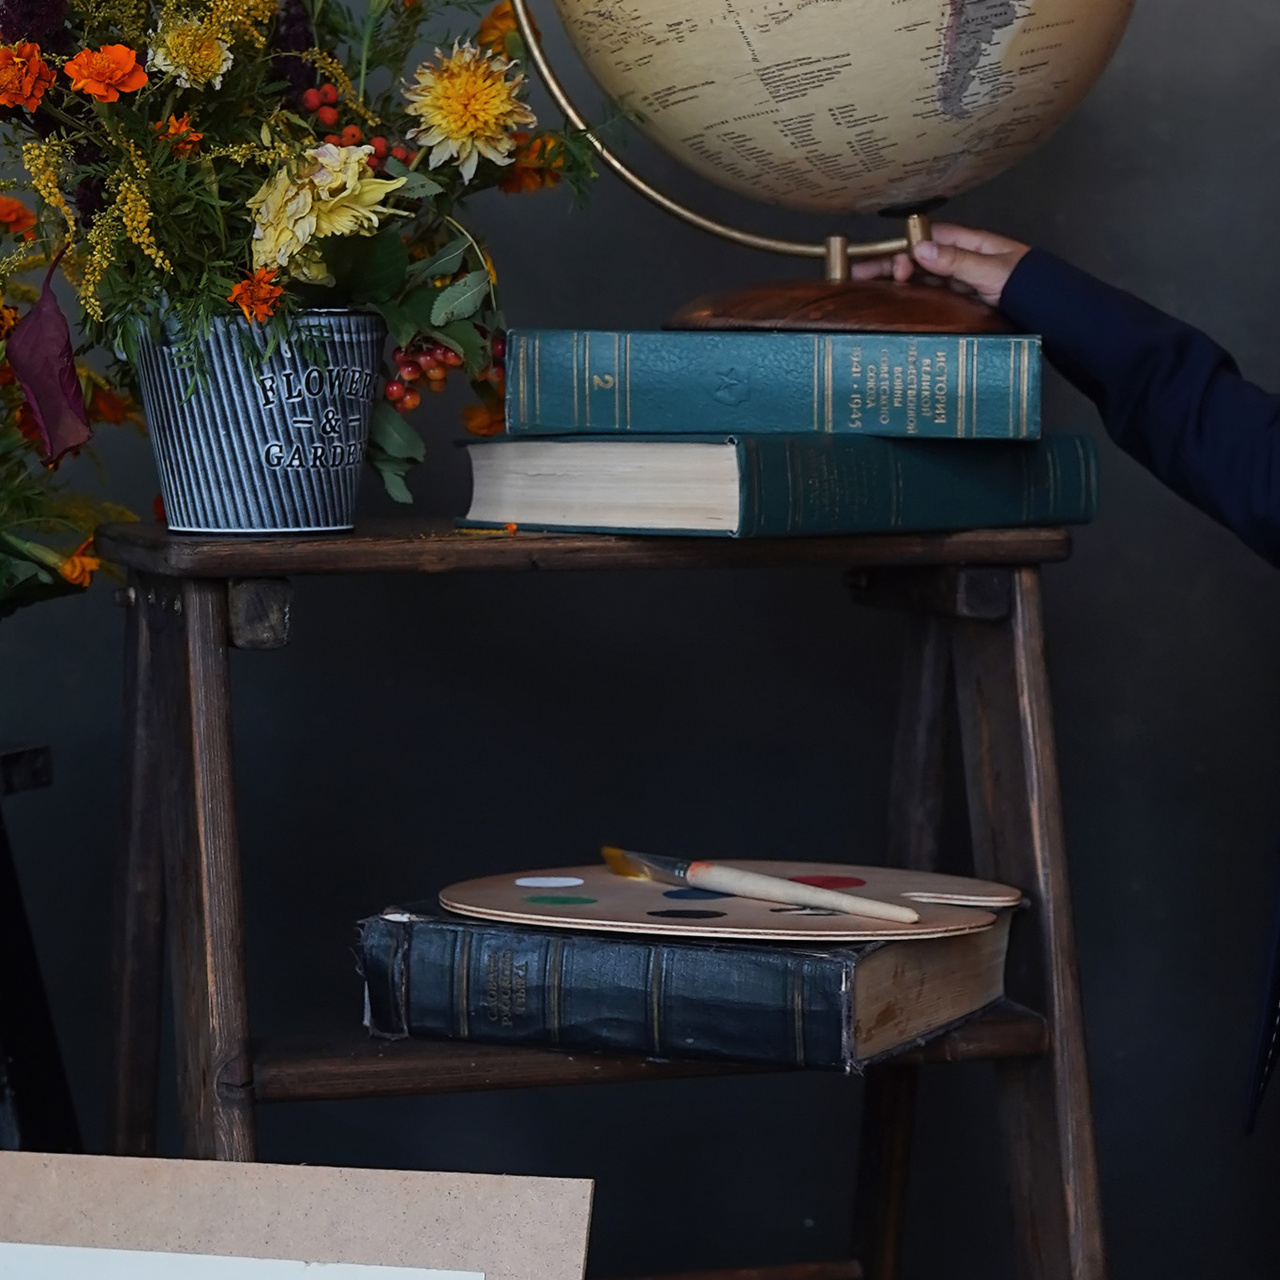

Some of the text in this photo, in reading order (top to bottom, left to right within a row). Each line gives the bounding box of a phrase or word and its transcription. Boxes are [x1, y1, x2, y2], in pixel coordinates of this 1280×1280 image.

[592, 374, 614, 390] 2
[893, 366, 903, 408] ВОЙНЫ
[921, 358, 933, 417] ВЕЛИКОЙ
[934, 351, 948, 424] ИСТОРИЯ
[321, 408, 341, 435] &
[848, 394, 862, 428] 1945
